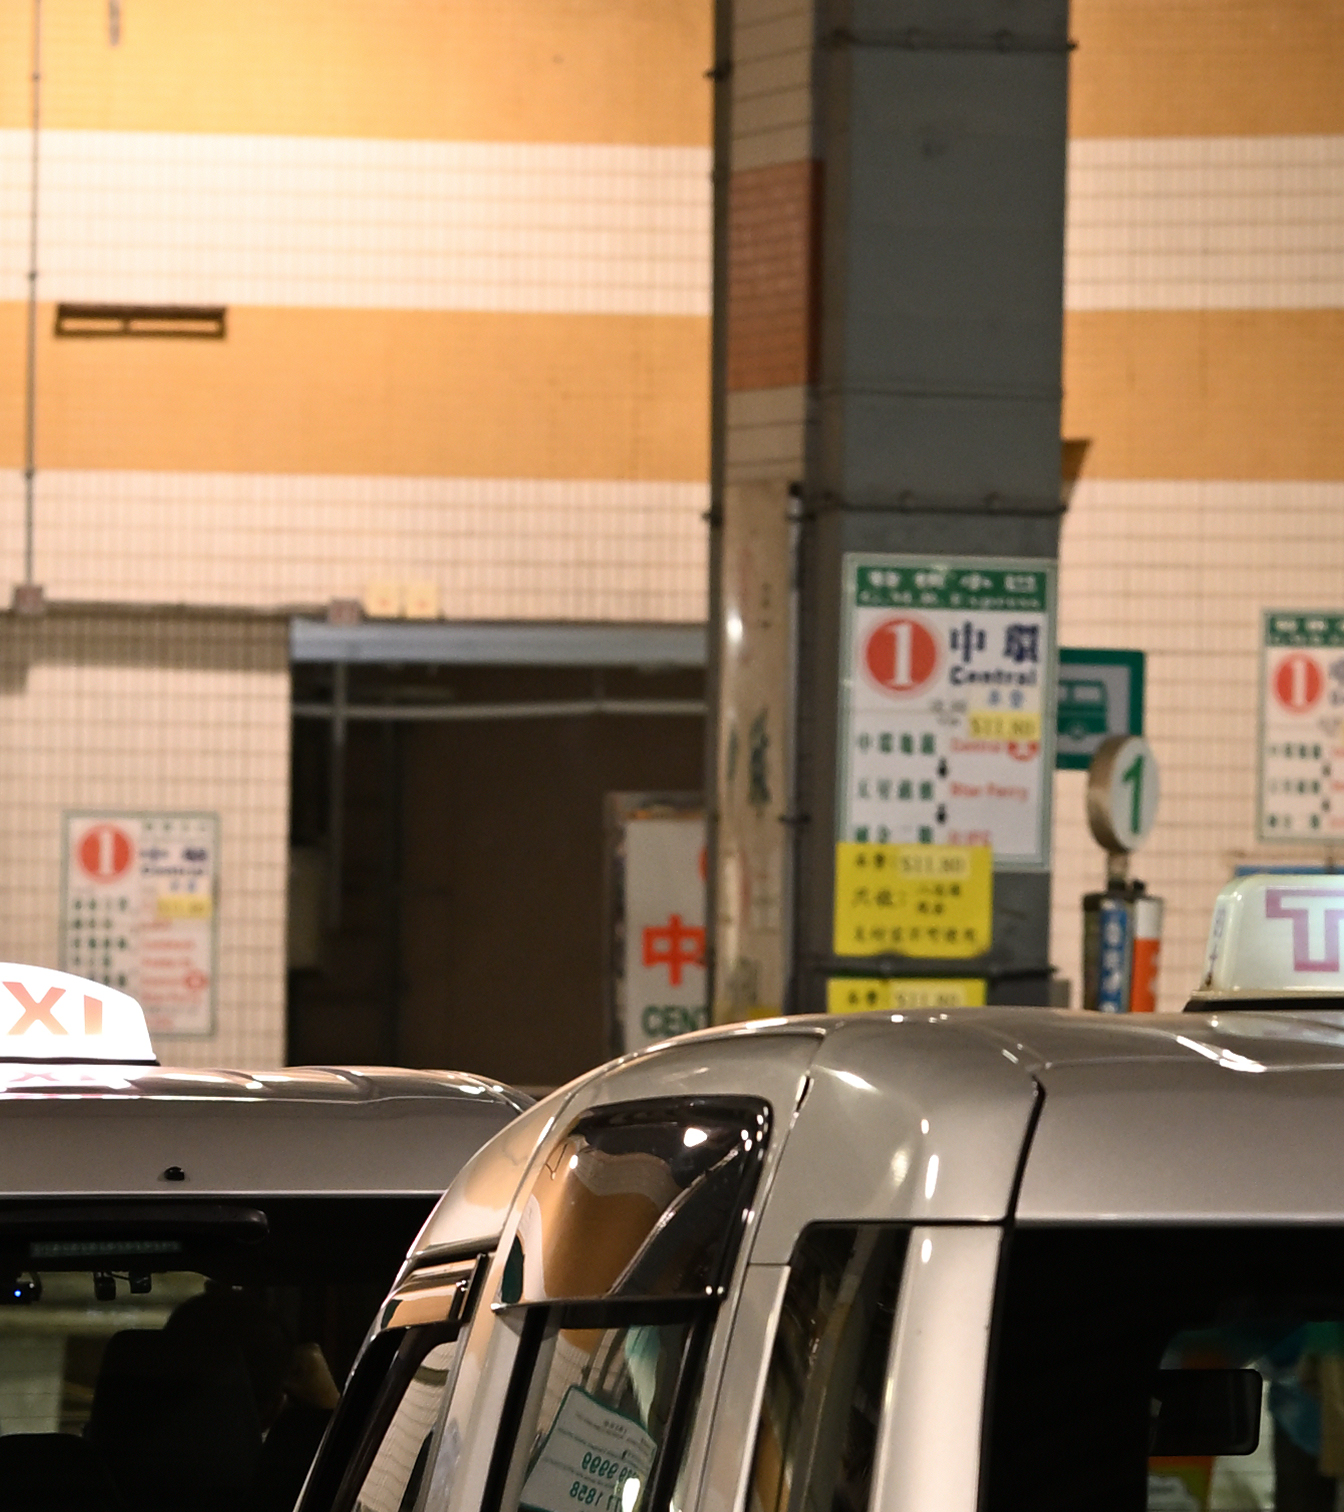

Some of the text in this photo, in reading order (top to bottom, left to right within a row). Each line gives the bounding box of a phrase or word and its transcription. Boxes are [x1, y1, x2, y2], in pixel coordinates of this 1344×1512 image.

[889, 624, 913, 685] 1
[950, 621, 1039, 663] 中環
[950, 665, 1037, 685] Central
[1123, 754, 1145, 834] 1
[642, 914, 709, 987] 中
